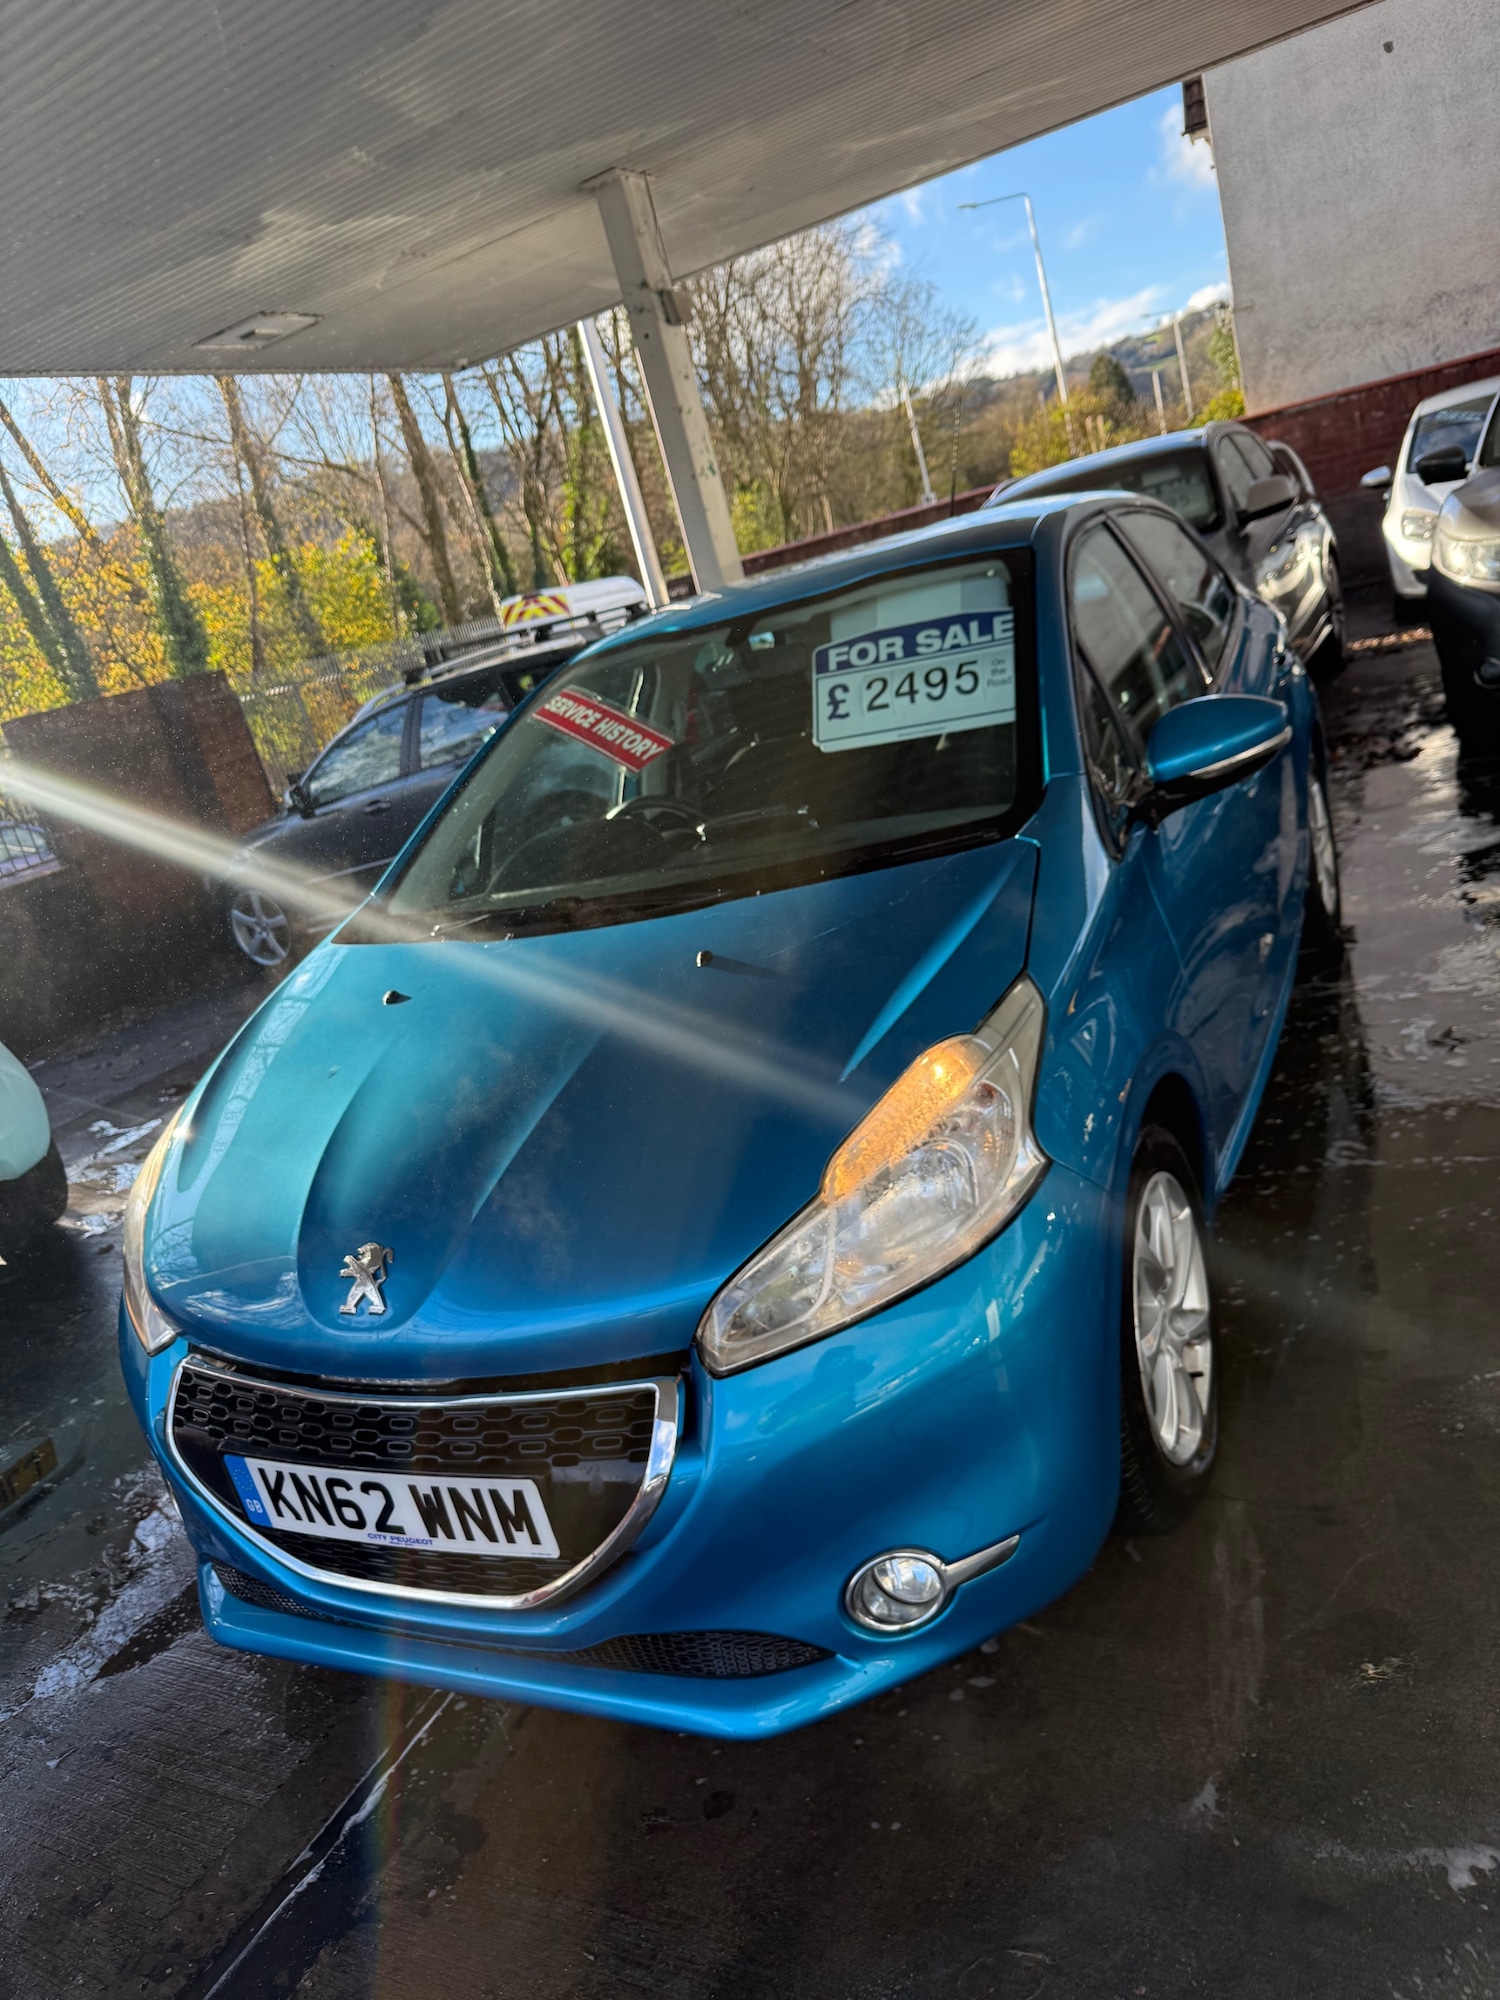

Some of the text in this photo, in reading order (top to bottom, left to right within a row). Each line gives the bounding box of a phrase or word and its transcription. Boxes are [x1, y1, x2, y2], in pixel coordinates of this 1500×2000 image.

[828, 614, 1014, 672] FOR SALE
[866, 660, 979, 712] 2495
[544, 696, 665, 760] SERVICE HISTORY
[245, 1498, 263, 1514] GB
[257, 1467, 542, 1545] KN62 WNM
[367, 1532, 387, 1540] CITY
[389, 1535, 433, 1545] PEUGEOT
